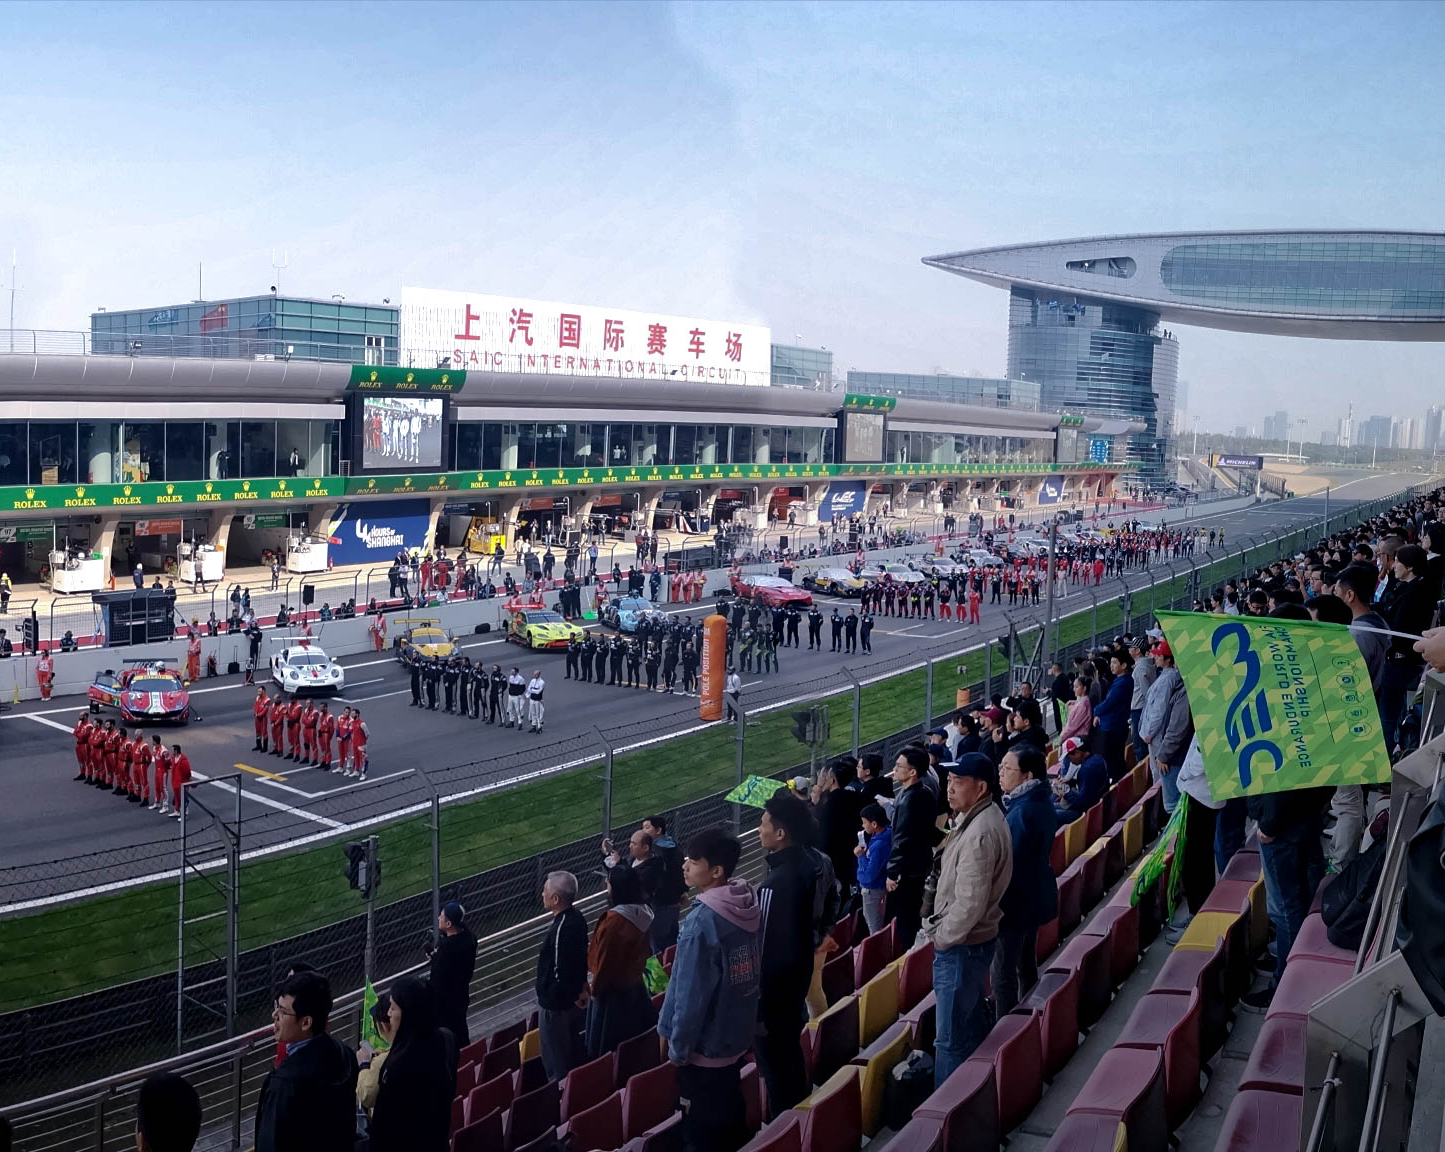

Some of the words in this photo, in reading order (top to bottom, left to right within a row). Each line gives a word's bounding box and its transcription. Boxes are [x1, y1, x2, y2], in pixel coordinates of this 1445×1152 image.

[454, 303, 743, 362] 上汽国际赛车场
[453, 350, 502, 366] SAIC
[359, 381, 383, 389] ROLEX
[396, 382, 419, 390] ROLEX
[431, 383, 454, 391] ROLEX
[428, 484, 450, 492] ROLEX
[197, 494, 222, 502] ROLEX
[235, 492, 259, 500] ROLEX
[272, 491, 294, 499] ROLEX
[15, 501, 47, 509] ROLEX
[65, 499, 97, 507] ROLEX
[114, 497, 142, 505] ROLEX
[371, 526, 390, 537] HOURS
[366, 535, 404, 548] SHANGHAI
[702, 677, 710, 696] POLE
